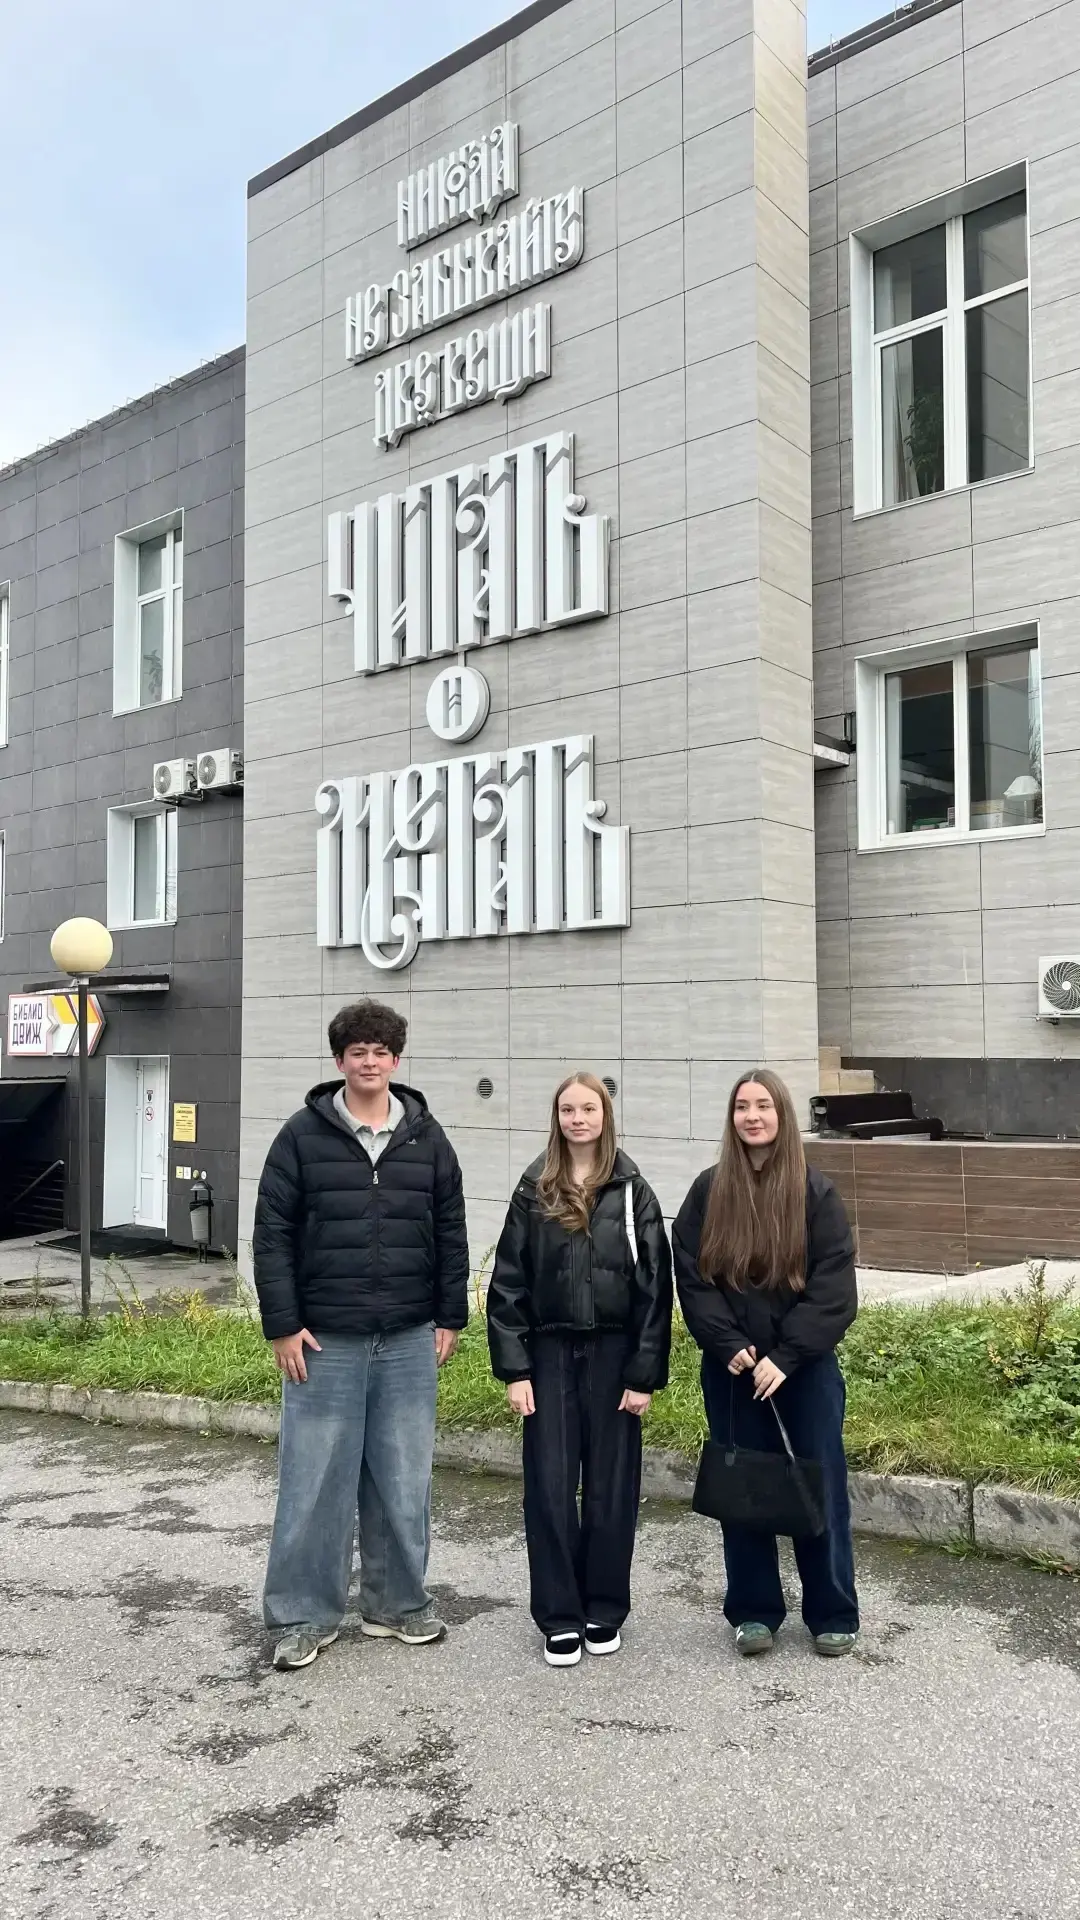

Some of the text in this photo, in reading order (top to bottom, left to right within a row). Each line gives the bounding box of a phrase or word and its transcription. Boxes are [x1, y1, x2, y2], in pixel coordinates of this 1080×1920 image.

[397, 120, 519, 248] НИКОГДА
[327, 430, 611, 675] ЧИТАТЬ
[315, 735, 631, 970] МЕЧТАТЬ
[12, 1022, 42, 1046] ДВИЖ
[13, 1003, 42, 1020] БИБЛИО
